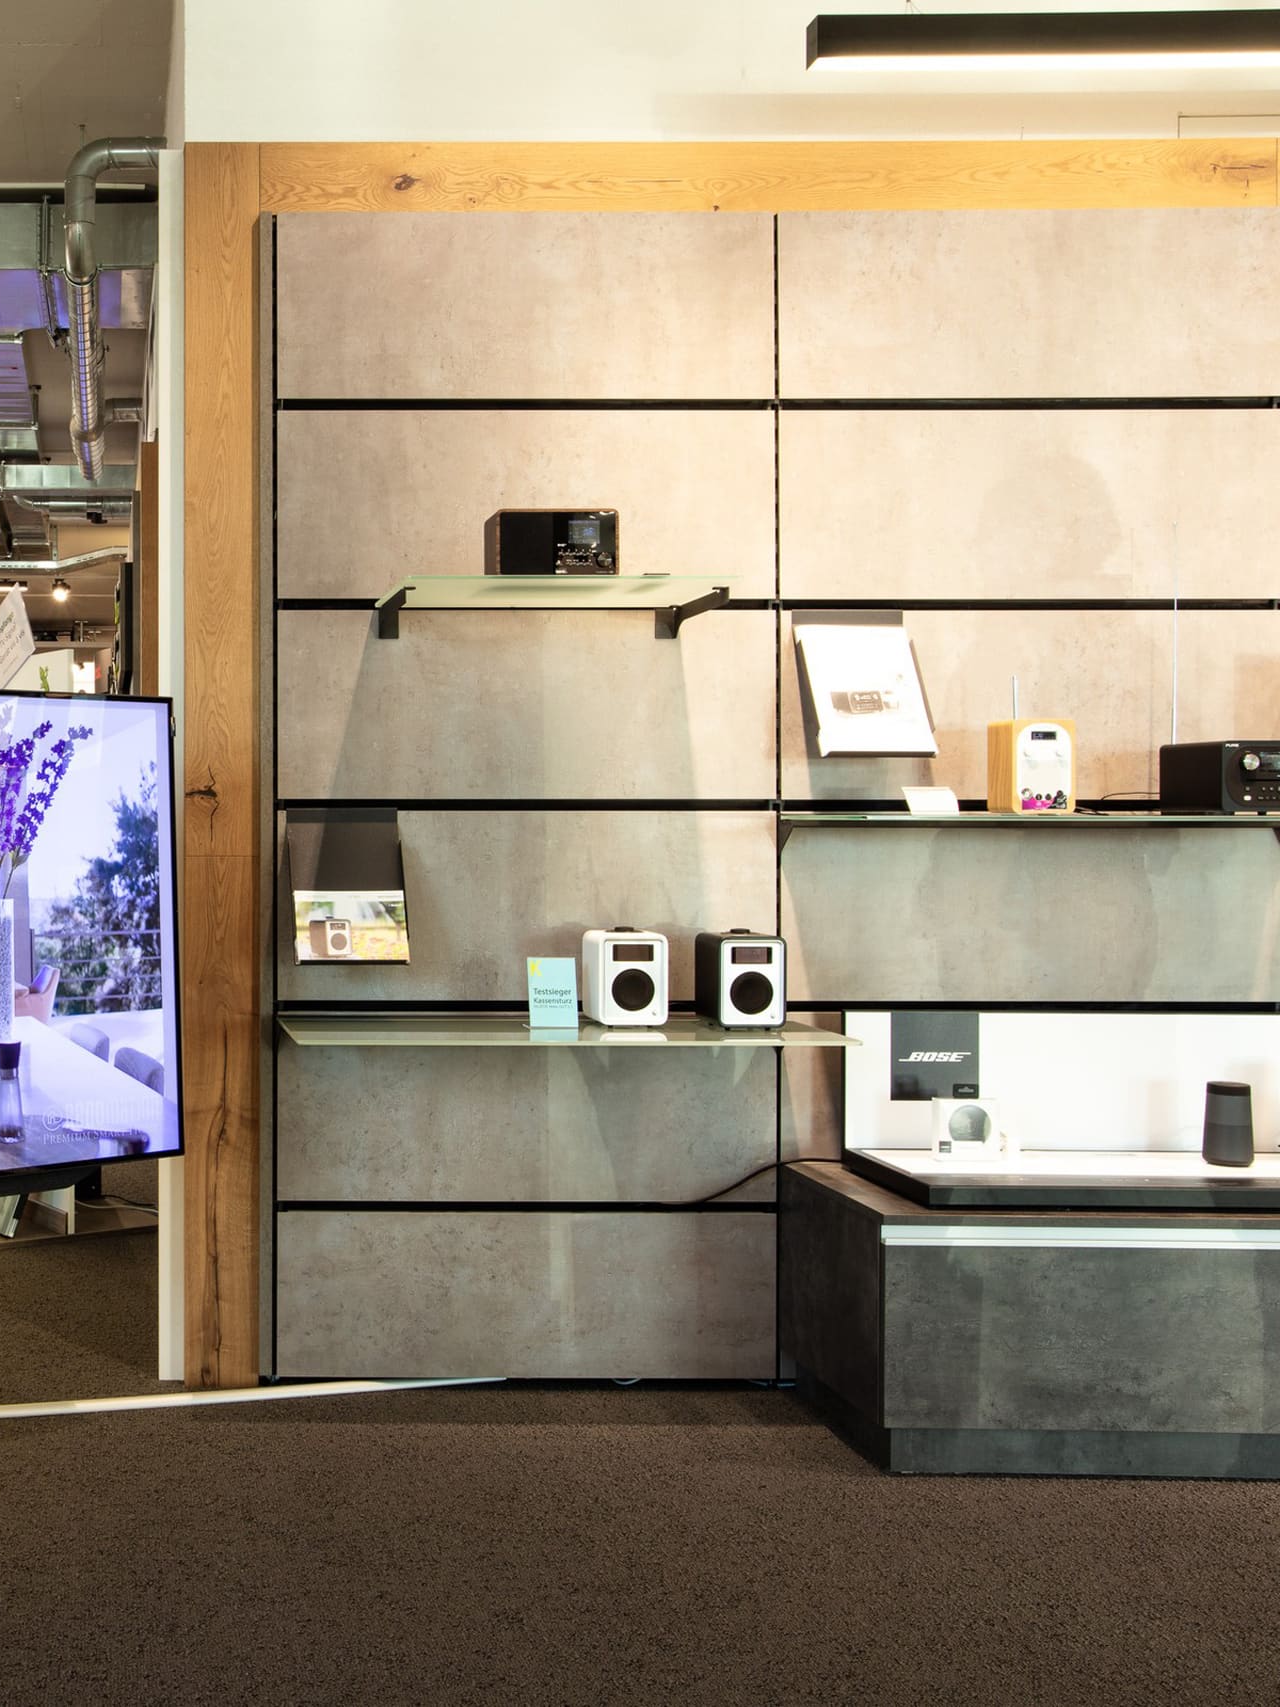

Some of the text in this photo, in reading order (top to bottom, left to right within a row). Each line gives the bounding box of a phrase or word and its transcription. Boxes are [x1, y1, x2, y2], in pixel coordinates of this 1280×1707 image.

[533, 987, 572, 997] Testsieger
[533, 997, 573, 1005] Kassensturz
[898, 1051, 972, 1062] BOSE
[42, 1130, 93, 1145] PREMIUM
